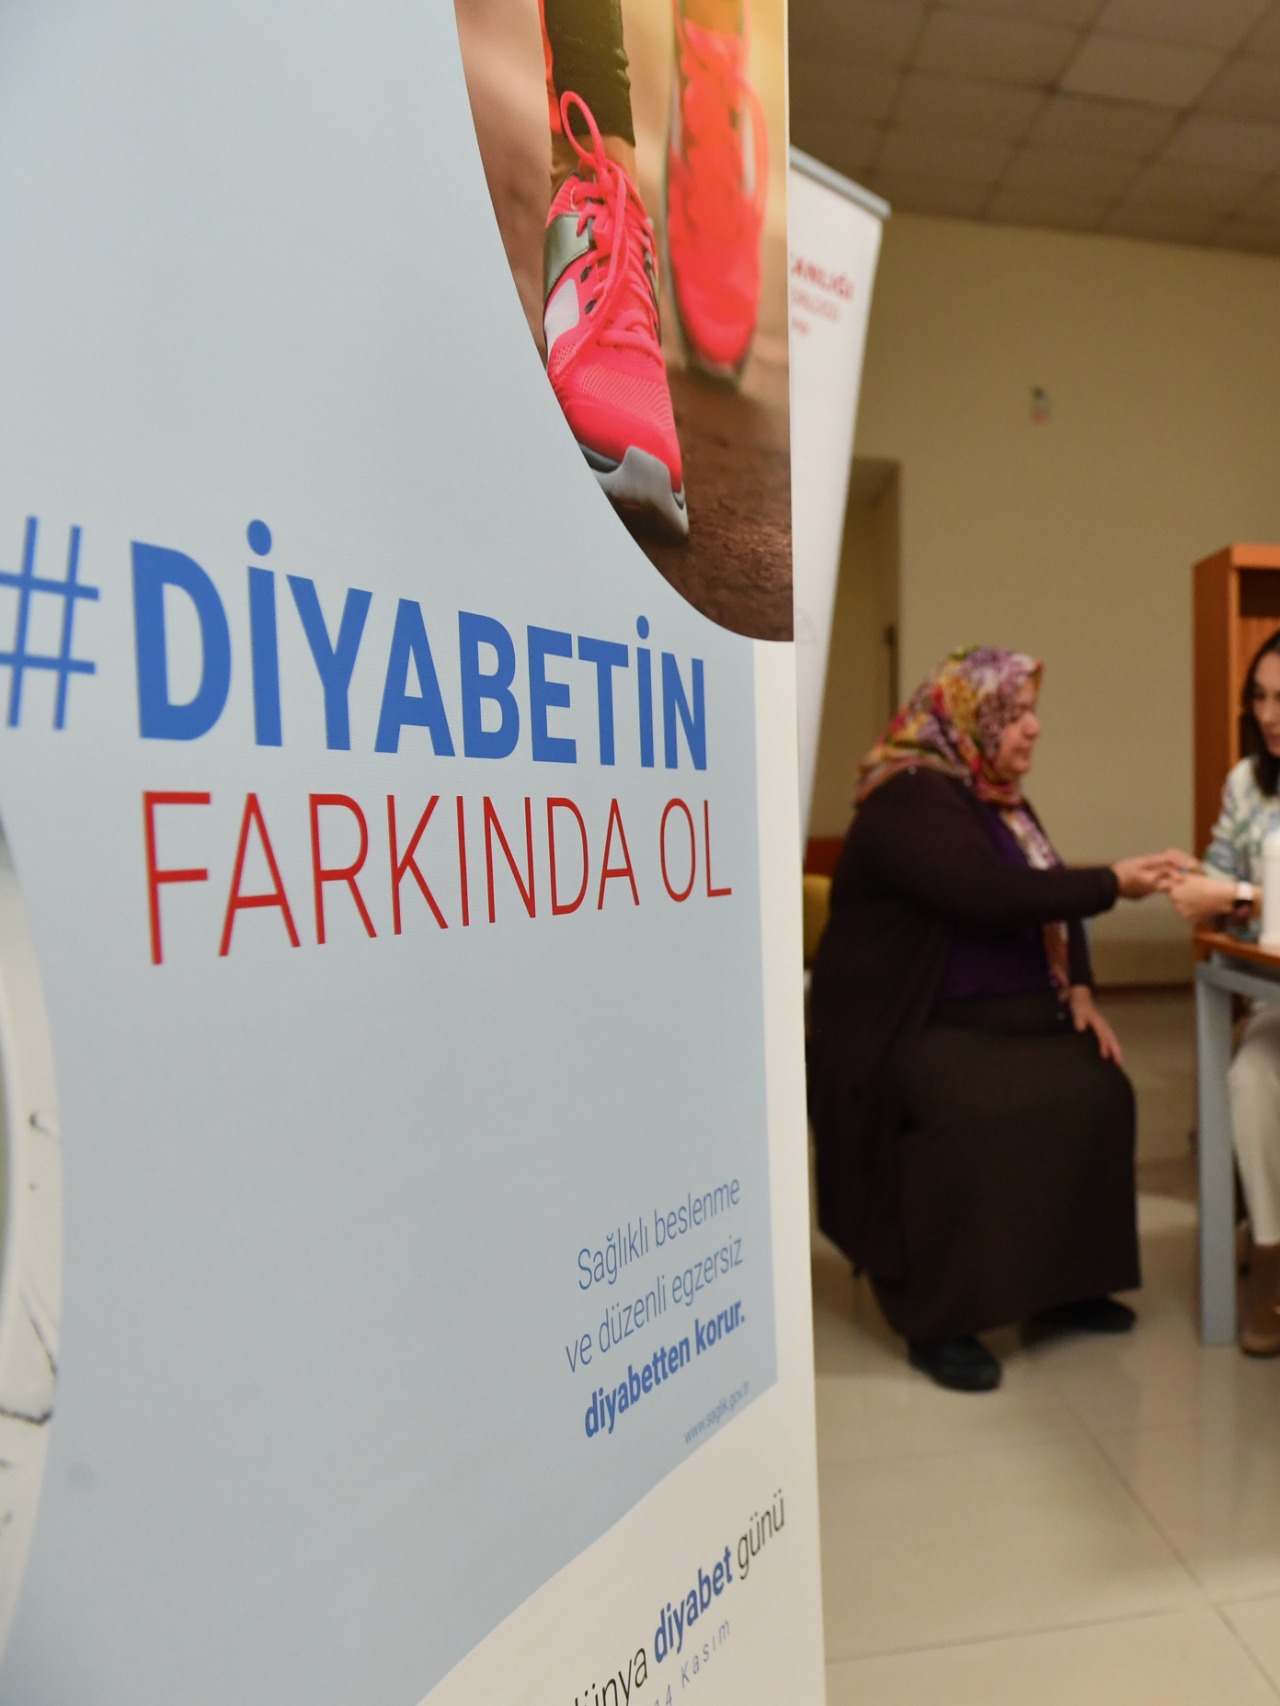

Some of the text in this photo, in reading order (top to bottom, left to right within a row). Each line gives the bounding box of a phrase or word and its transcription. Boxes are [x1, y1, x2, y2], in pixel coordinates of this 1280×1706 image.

[0, 515, 707, 771] #DİYABETİN
[142, 791, 732, 965] FARKINDA OL
[578, 1179, 740, 1290] Sağlıklı beslenme
[566, 1236, 743, 1373] ve düzenli egzersiz
[585, 1300, 745, 1438] diyabetten korur.
[654, 1545, 732, 1663] diyabet
[737, 1489, 784, 1580] günü
[680, 1620, 731, 1689] Kasım
